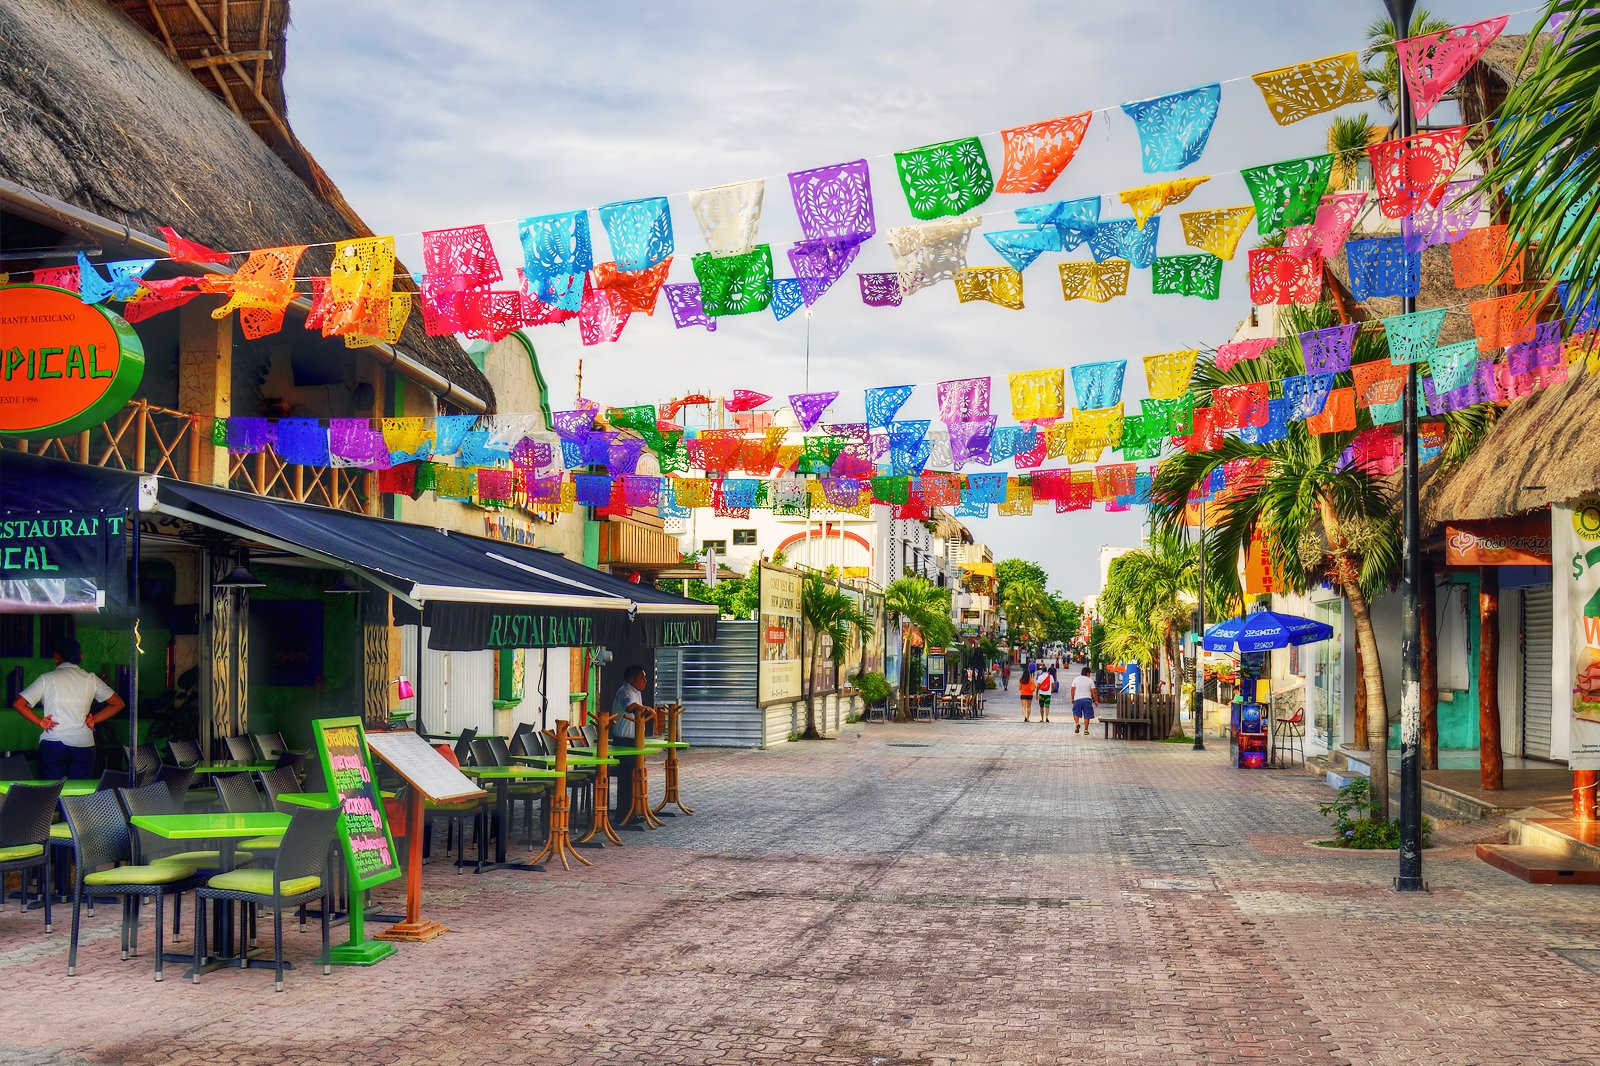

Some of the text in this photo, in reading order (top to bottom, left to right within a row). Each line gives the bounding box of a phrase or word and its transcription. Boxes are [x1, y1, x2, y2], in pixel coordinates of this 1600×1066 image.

[30, 313, 76, 323] MEXICANO
[0, 344, 113, 381] PICAL
[0, 517, 124, 539] STAURANT
[0, 546, 60, 572] CAL
